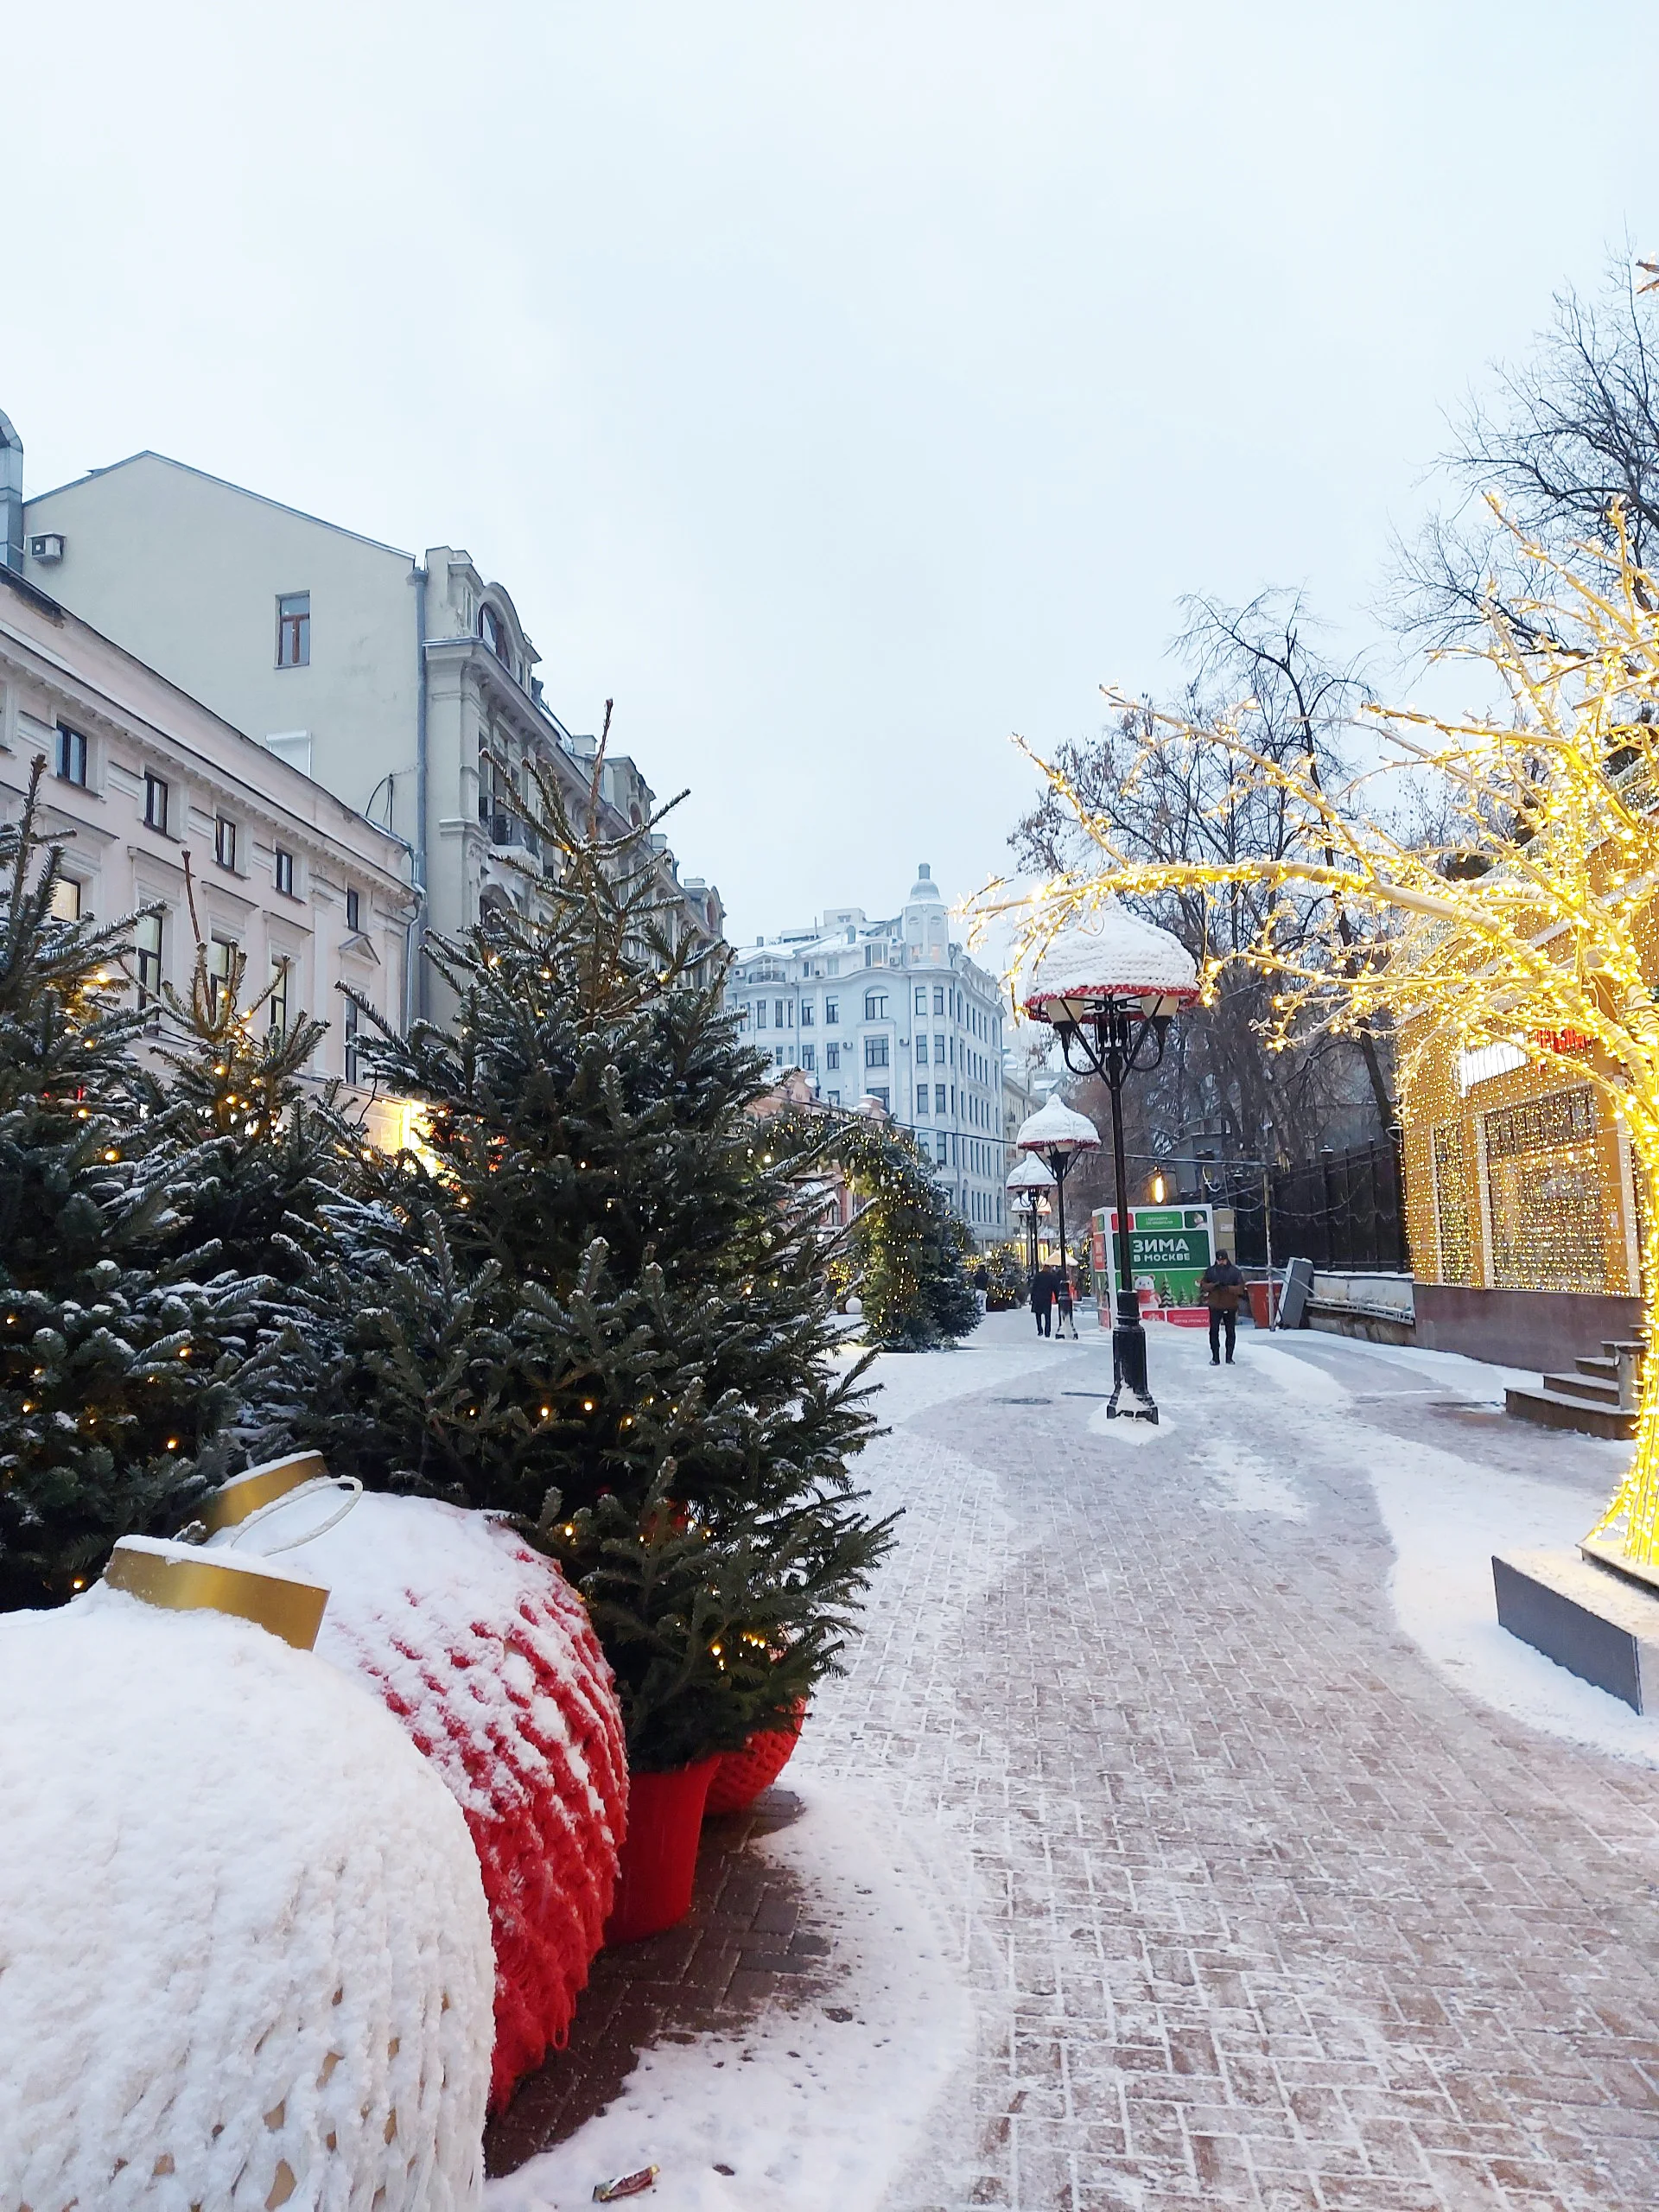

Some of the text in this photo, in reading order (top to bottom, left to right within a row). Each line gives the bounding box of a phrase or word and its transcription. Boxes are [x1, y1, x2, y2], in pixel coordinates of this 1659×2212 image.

[1132, 1238, 1190, 1253] ЗИМА
[1133, 1253, 1191, 1262] В МОСКВЕ
